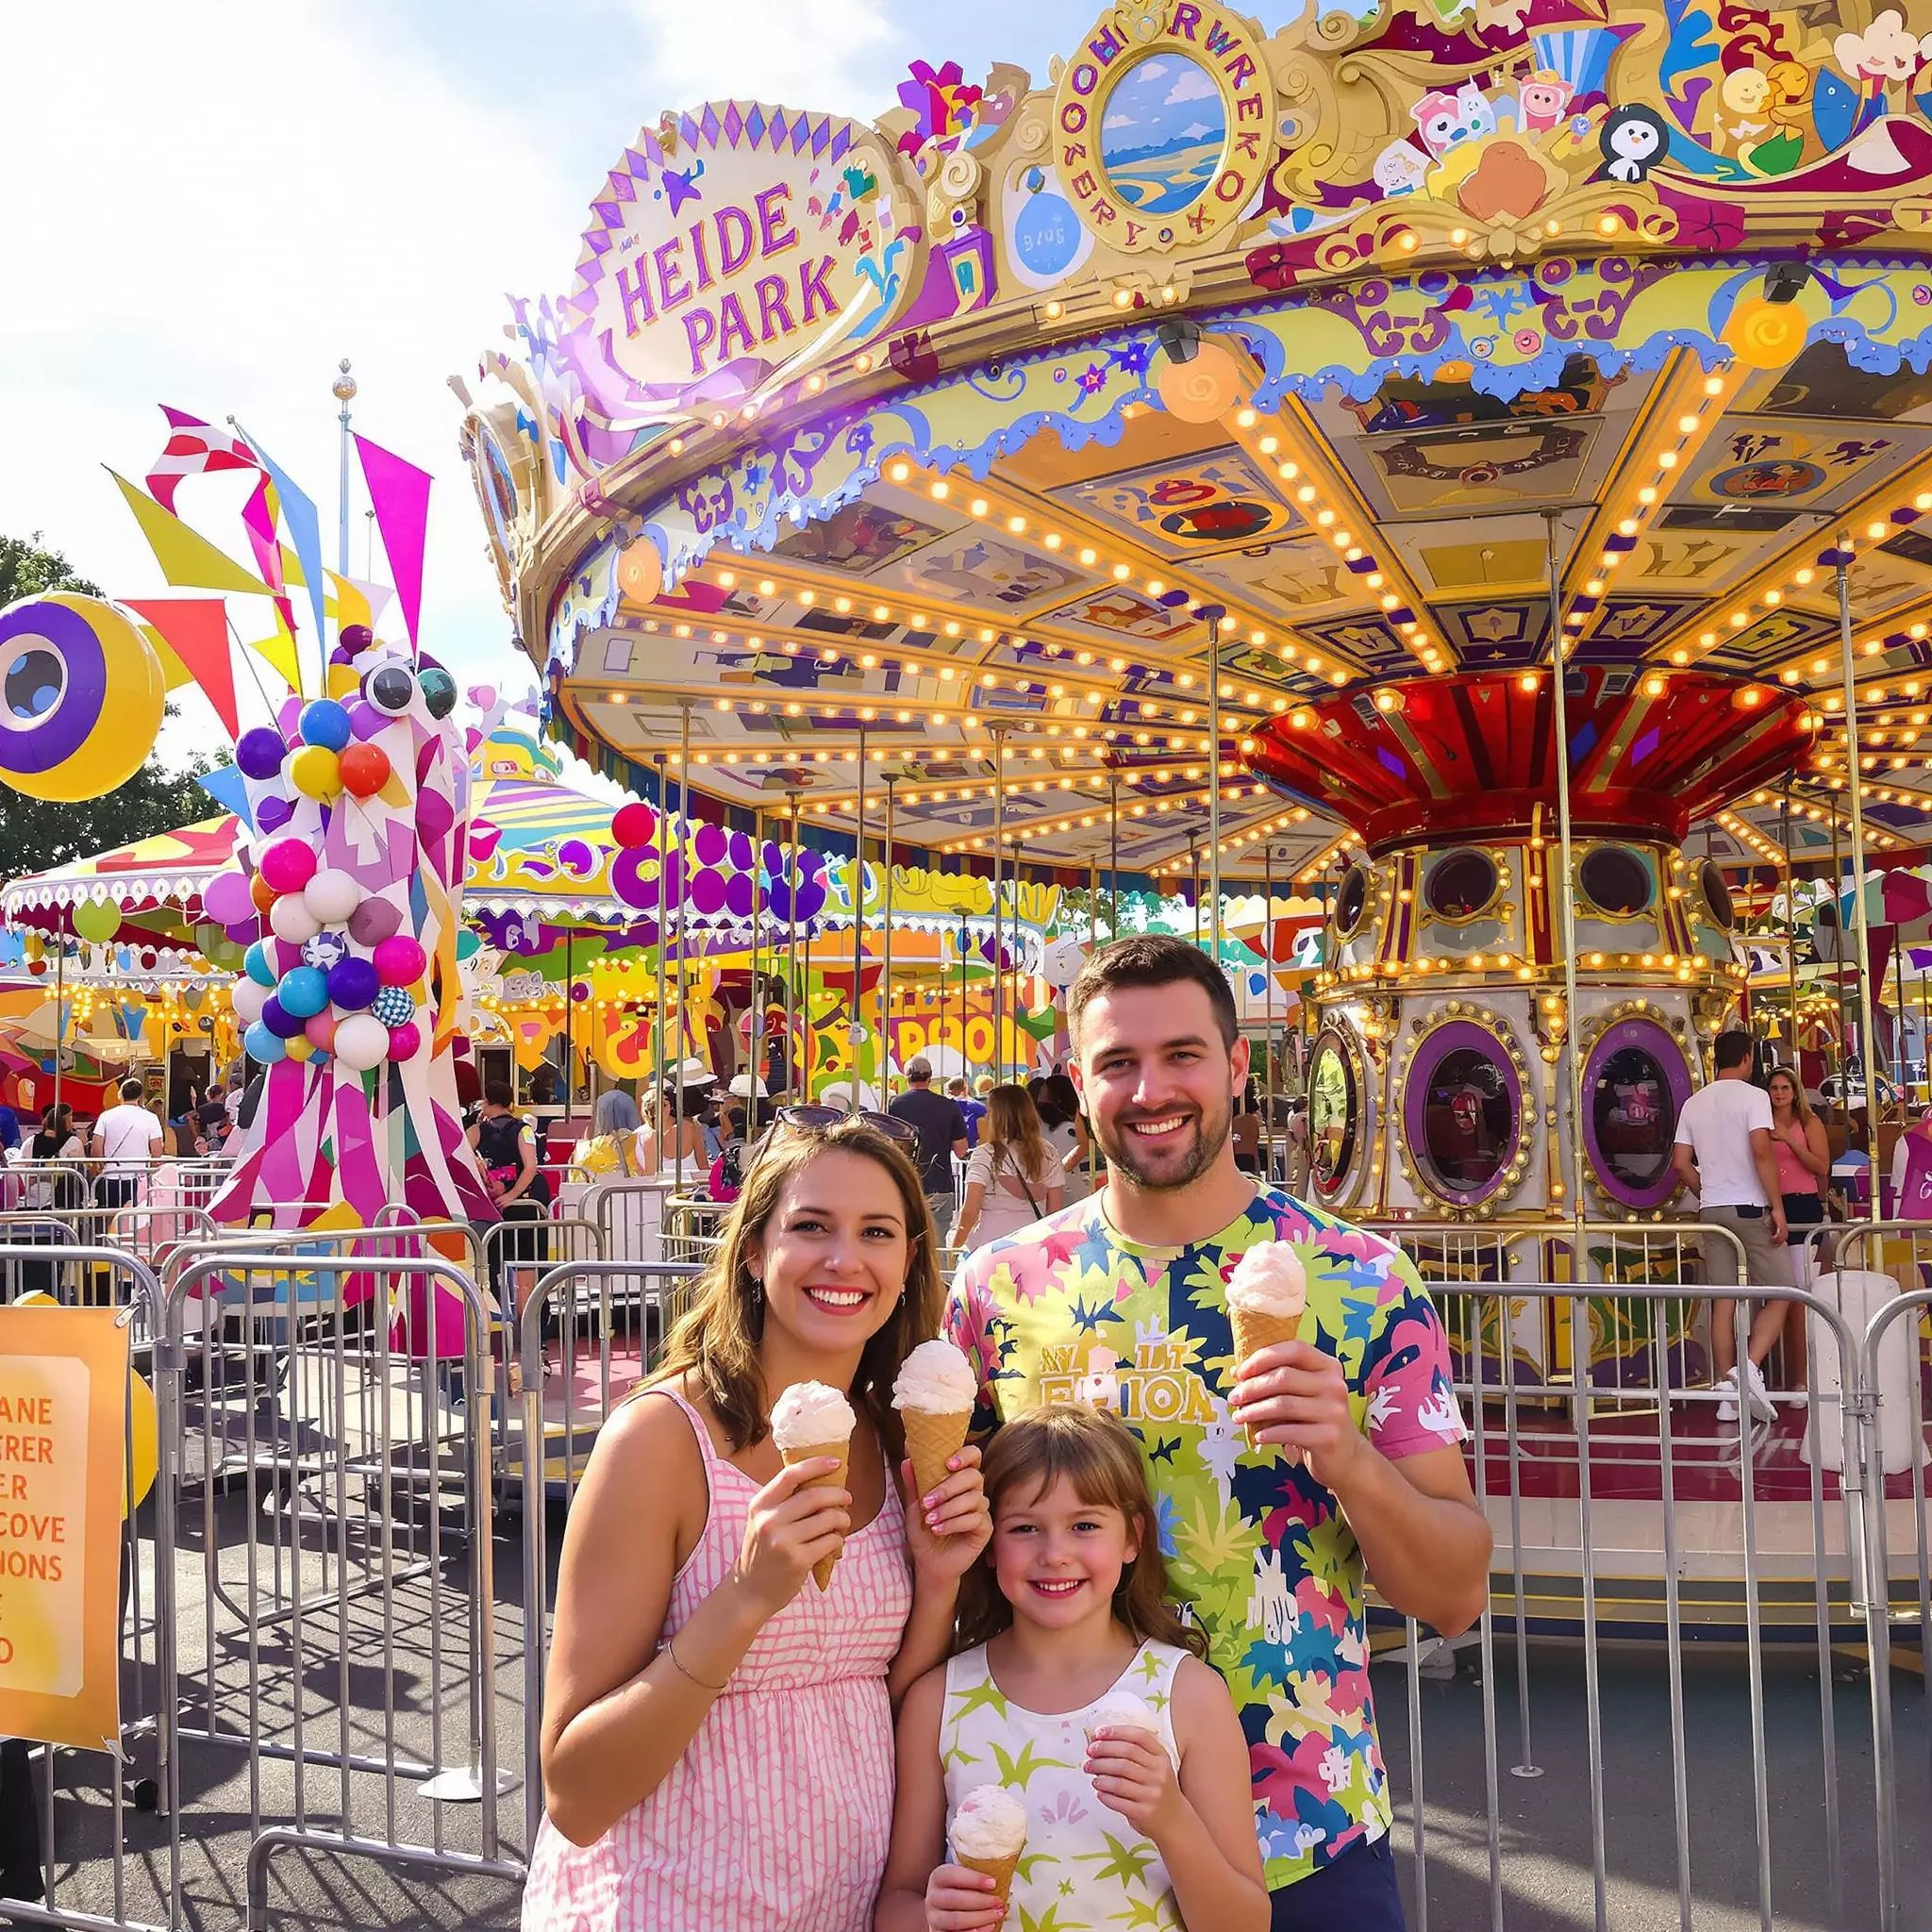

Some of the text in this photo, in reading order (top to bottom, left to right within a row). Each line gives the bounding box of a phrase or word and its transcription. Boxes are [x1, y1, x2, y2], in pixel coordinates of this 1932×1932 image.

[615, 182, 798, 339] HEIDE
[681, 255, 842, 375] PARK
[0, 1396, 53, 1425] ANE
[0, 1434, 54, 1465] RER
